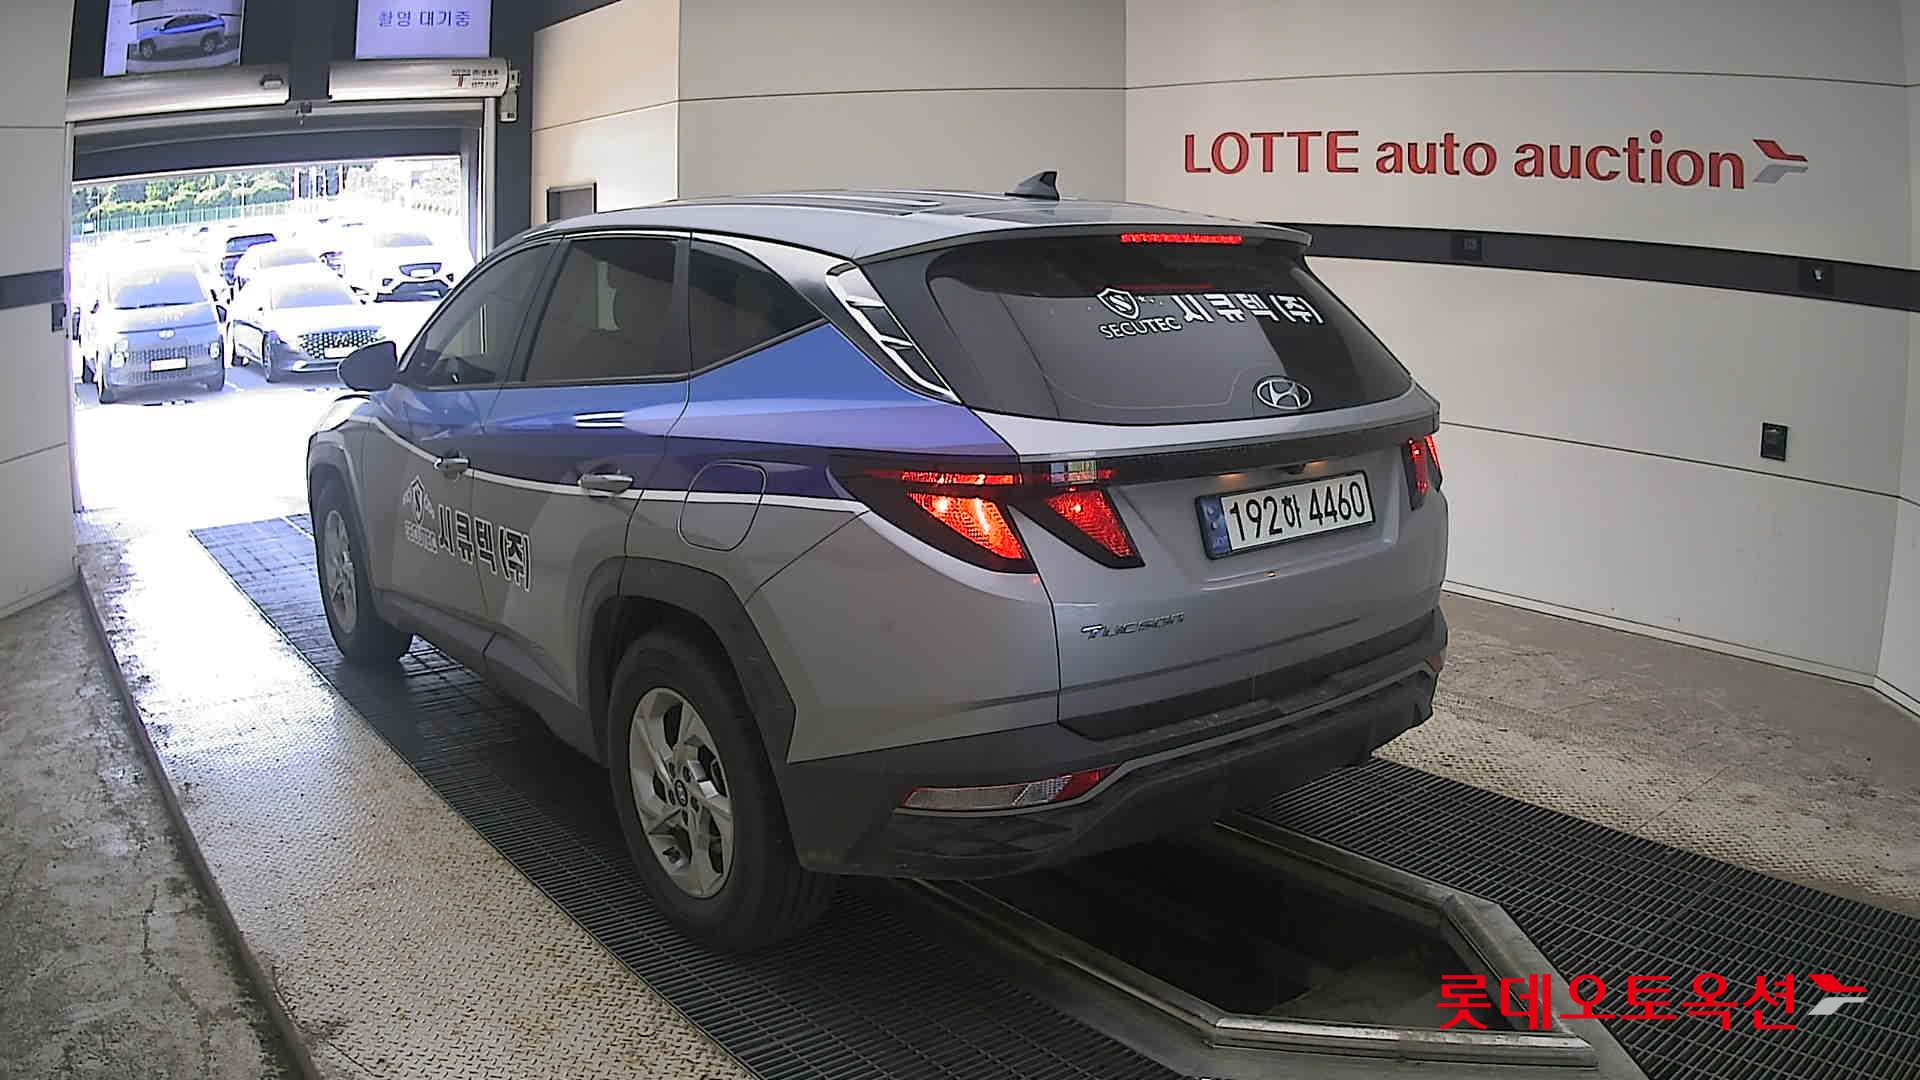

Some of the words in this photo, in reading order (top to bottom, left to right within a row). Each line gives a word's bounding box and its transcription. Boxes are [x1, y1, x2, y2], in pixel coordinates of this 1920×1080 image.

[419, 10, 473, 27] 대기중
[1185, 130, 1358, 174] LOTTE
[1376, 133, 1497, 177] auto
[1514, 130, 1745, 189] auction
[1099, 317, 1183, 339] SECUTEC
[1229, 495, 1302, 541] 192하
[1309, 482, 1366, 526] 4460
